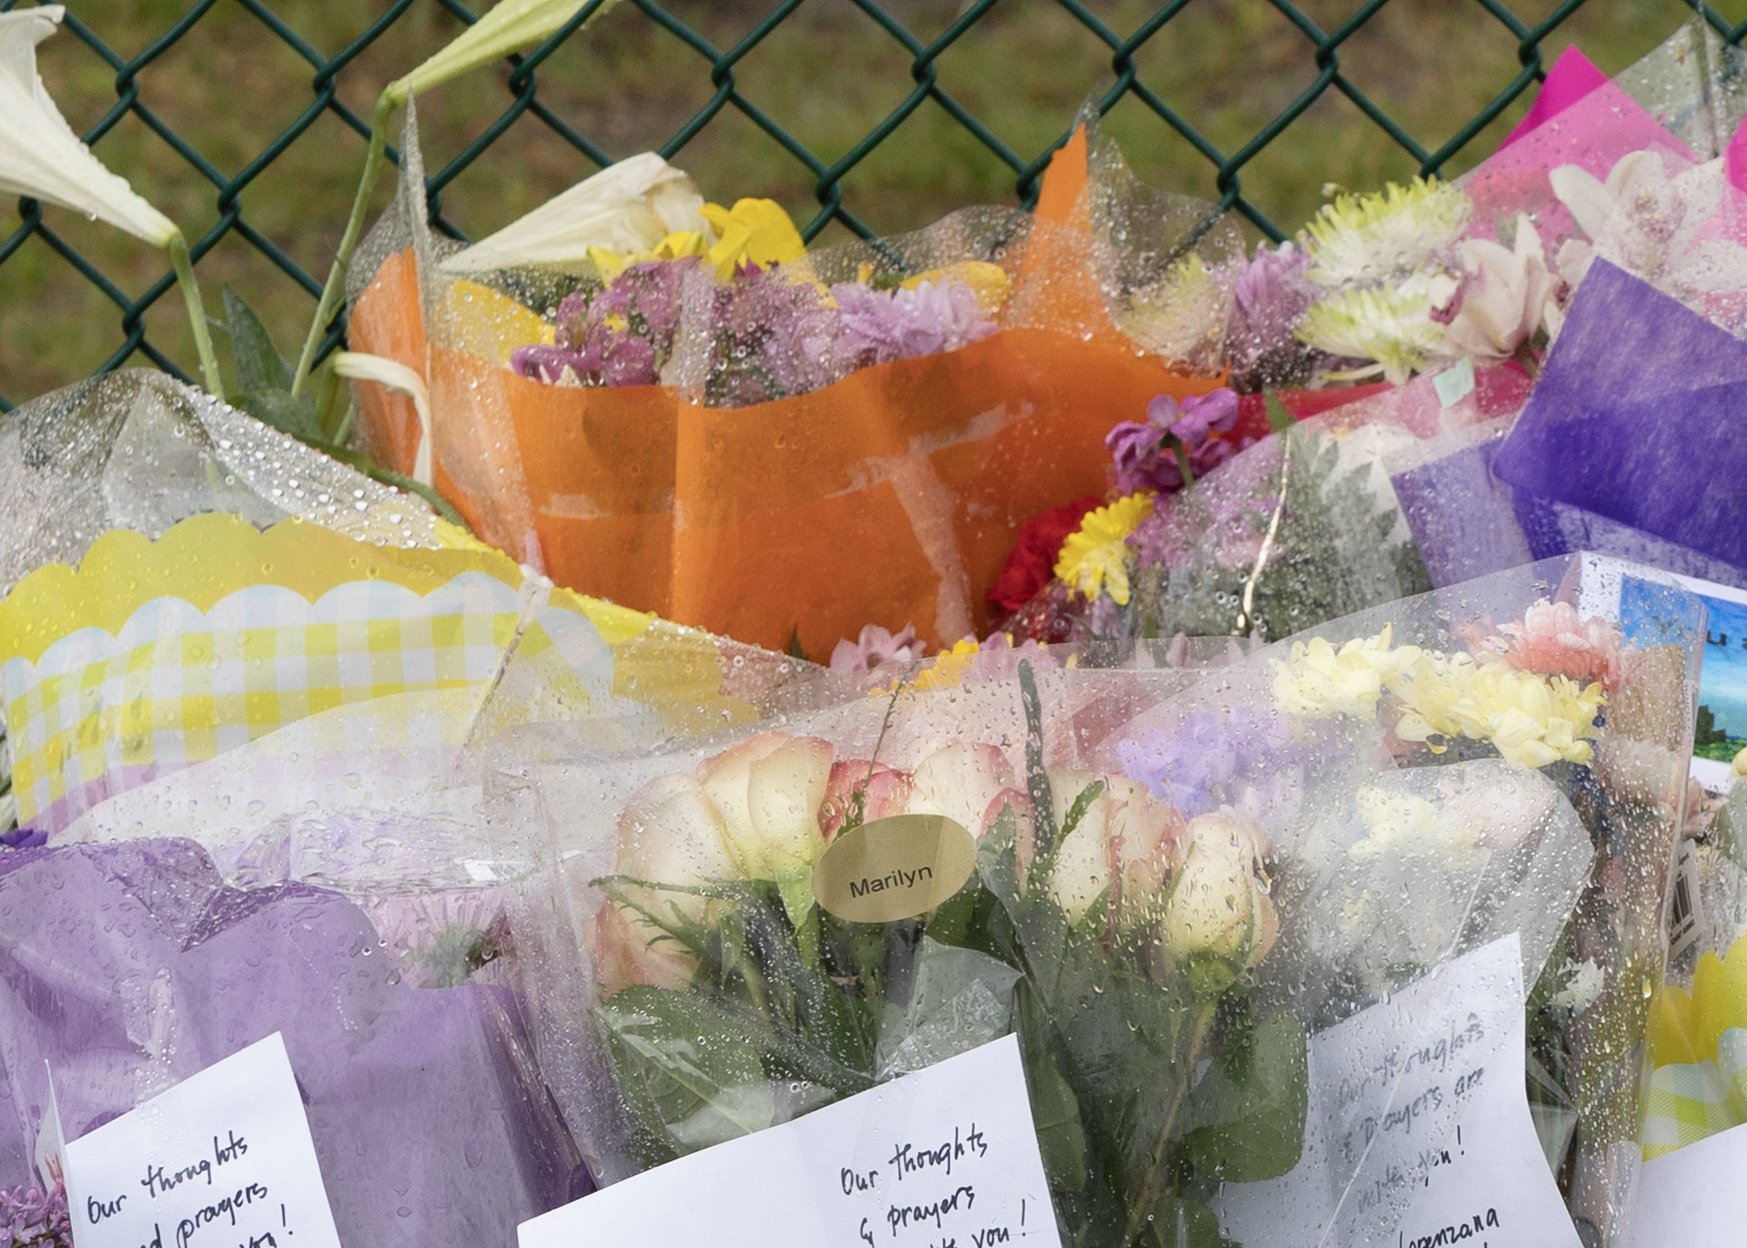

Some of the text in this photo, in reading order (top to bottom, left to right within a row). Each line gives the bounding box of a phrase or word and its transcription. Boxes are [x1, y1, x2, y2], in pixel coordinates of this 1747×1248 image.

[1650, 615, 1727, 647] Yu
[850, 866, 933, 899] Marilyn
[87, 1129, 249, 1225] Our thoughts
[840, 1122, 988, 1197] Our thoughts
[886, 1184, 976, 1237] prayers
